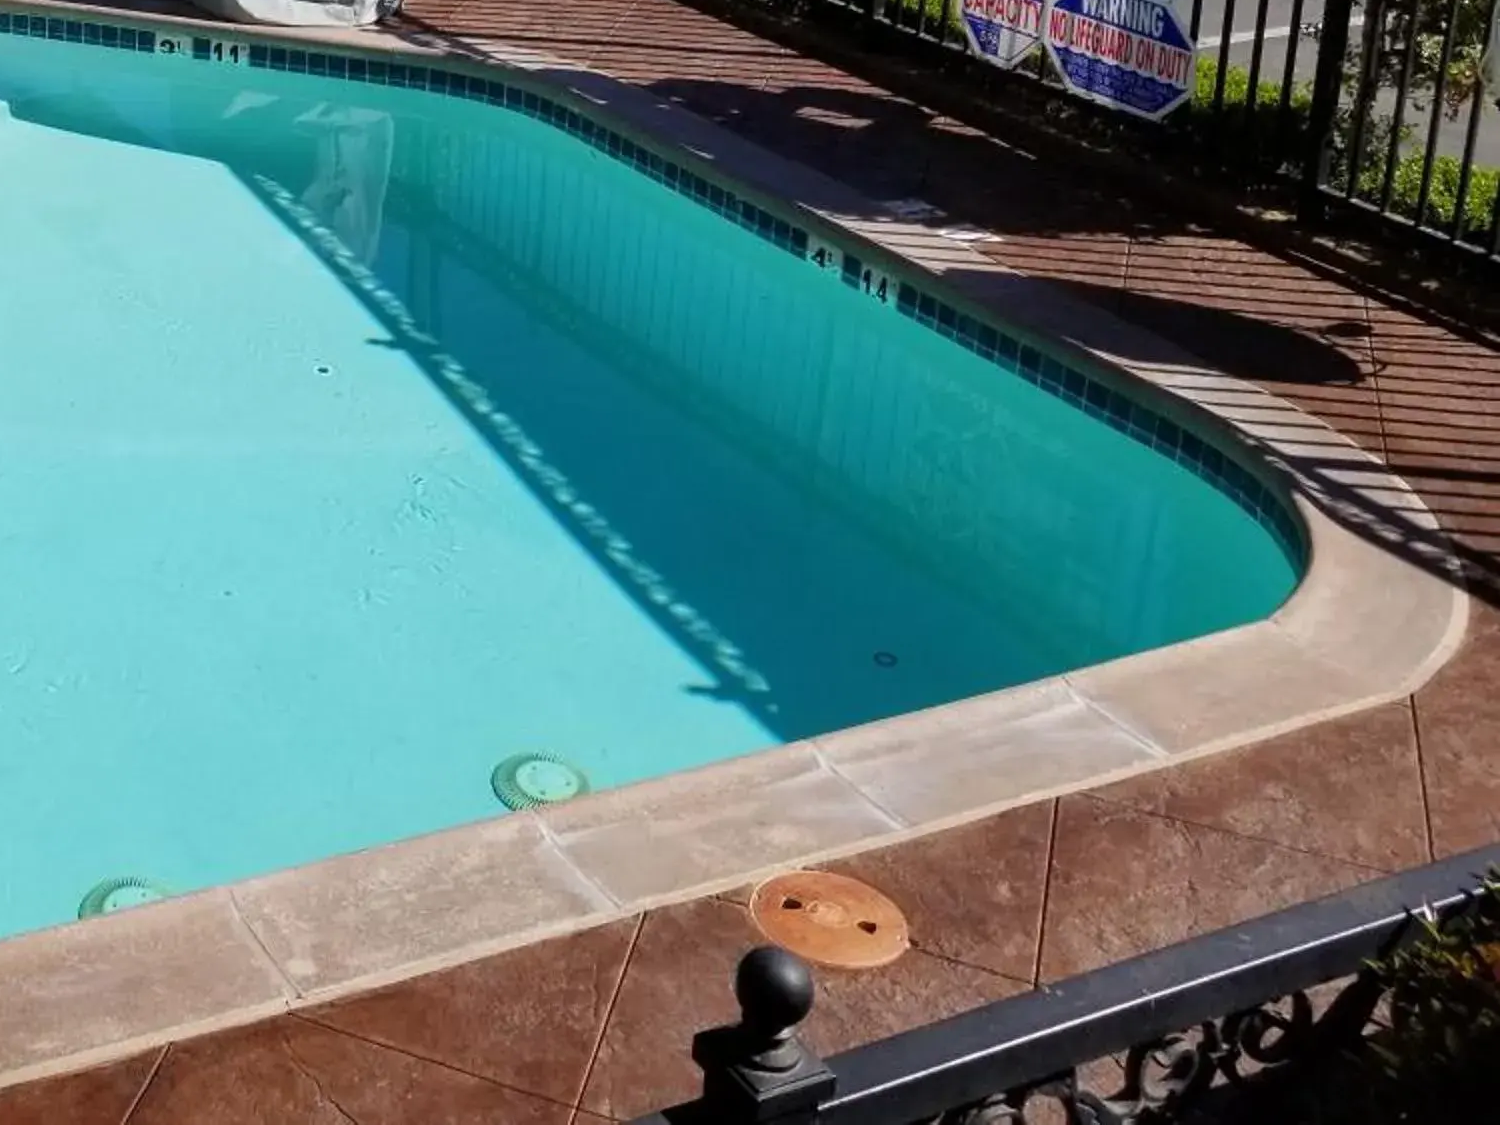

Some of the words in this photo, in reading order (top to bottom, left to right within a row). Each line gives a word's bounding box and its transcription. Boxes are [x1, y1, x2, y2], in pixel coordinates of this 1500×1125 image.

[1049, 9, 1067, 42] NO
[1070, 15, 1133, 64] LIFEGUARD
[1135, 38, 1155, 72] ON
[1158, 45, 1192, 85] DUTY
